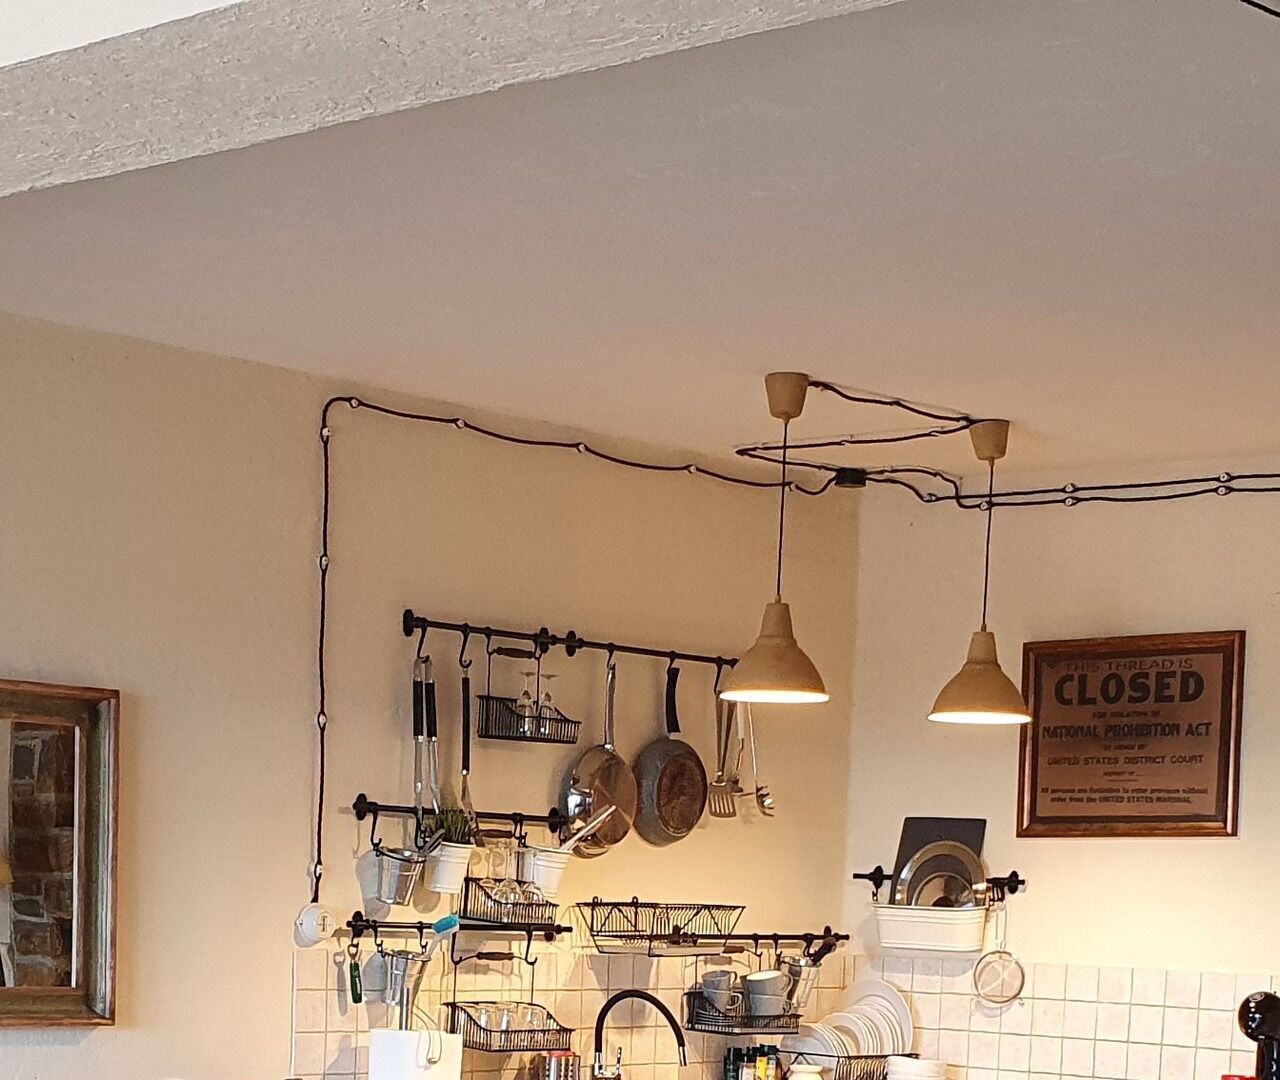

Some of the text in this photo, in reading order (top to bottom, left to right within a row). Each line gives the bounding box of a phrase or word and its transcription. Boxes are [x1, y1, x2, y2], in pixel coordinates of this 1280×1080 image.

[1107, 660, 1173, 671] THREAD
[1179, 658, 1193, 670] IS
[1054, 670, 1205, 705] CLOSED
[1042, 722, 1213, 740] NATIONAL PROHIBITION ACT
[1047, 754, 1204, 766] UNITED STATES DISTRICT COURT
